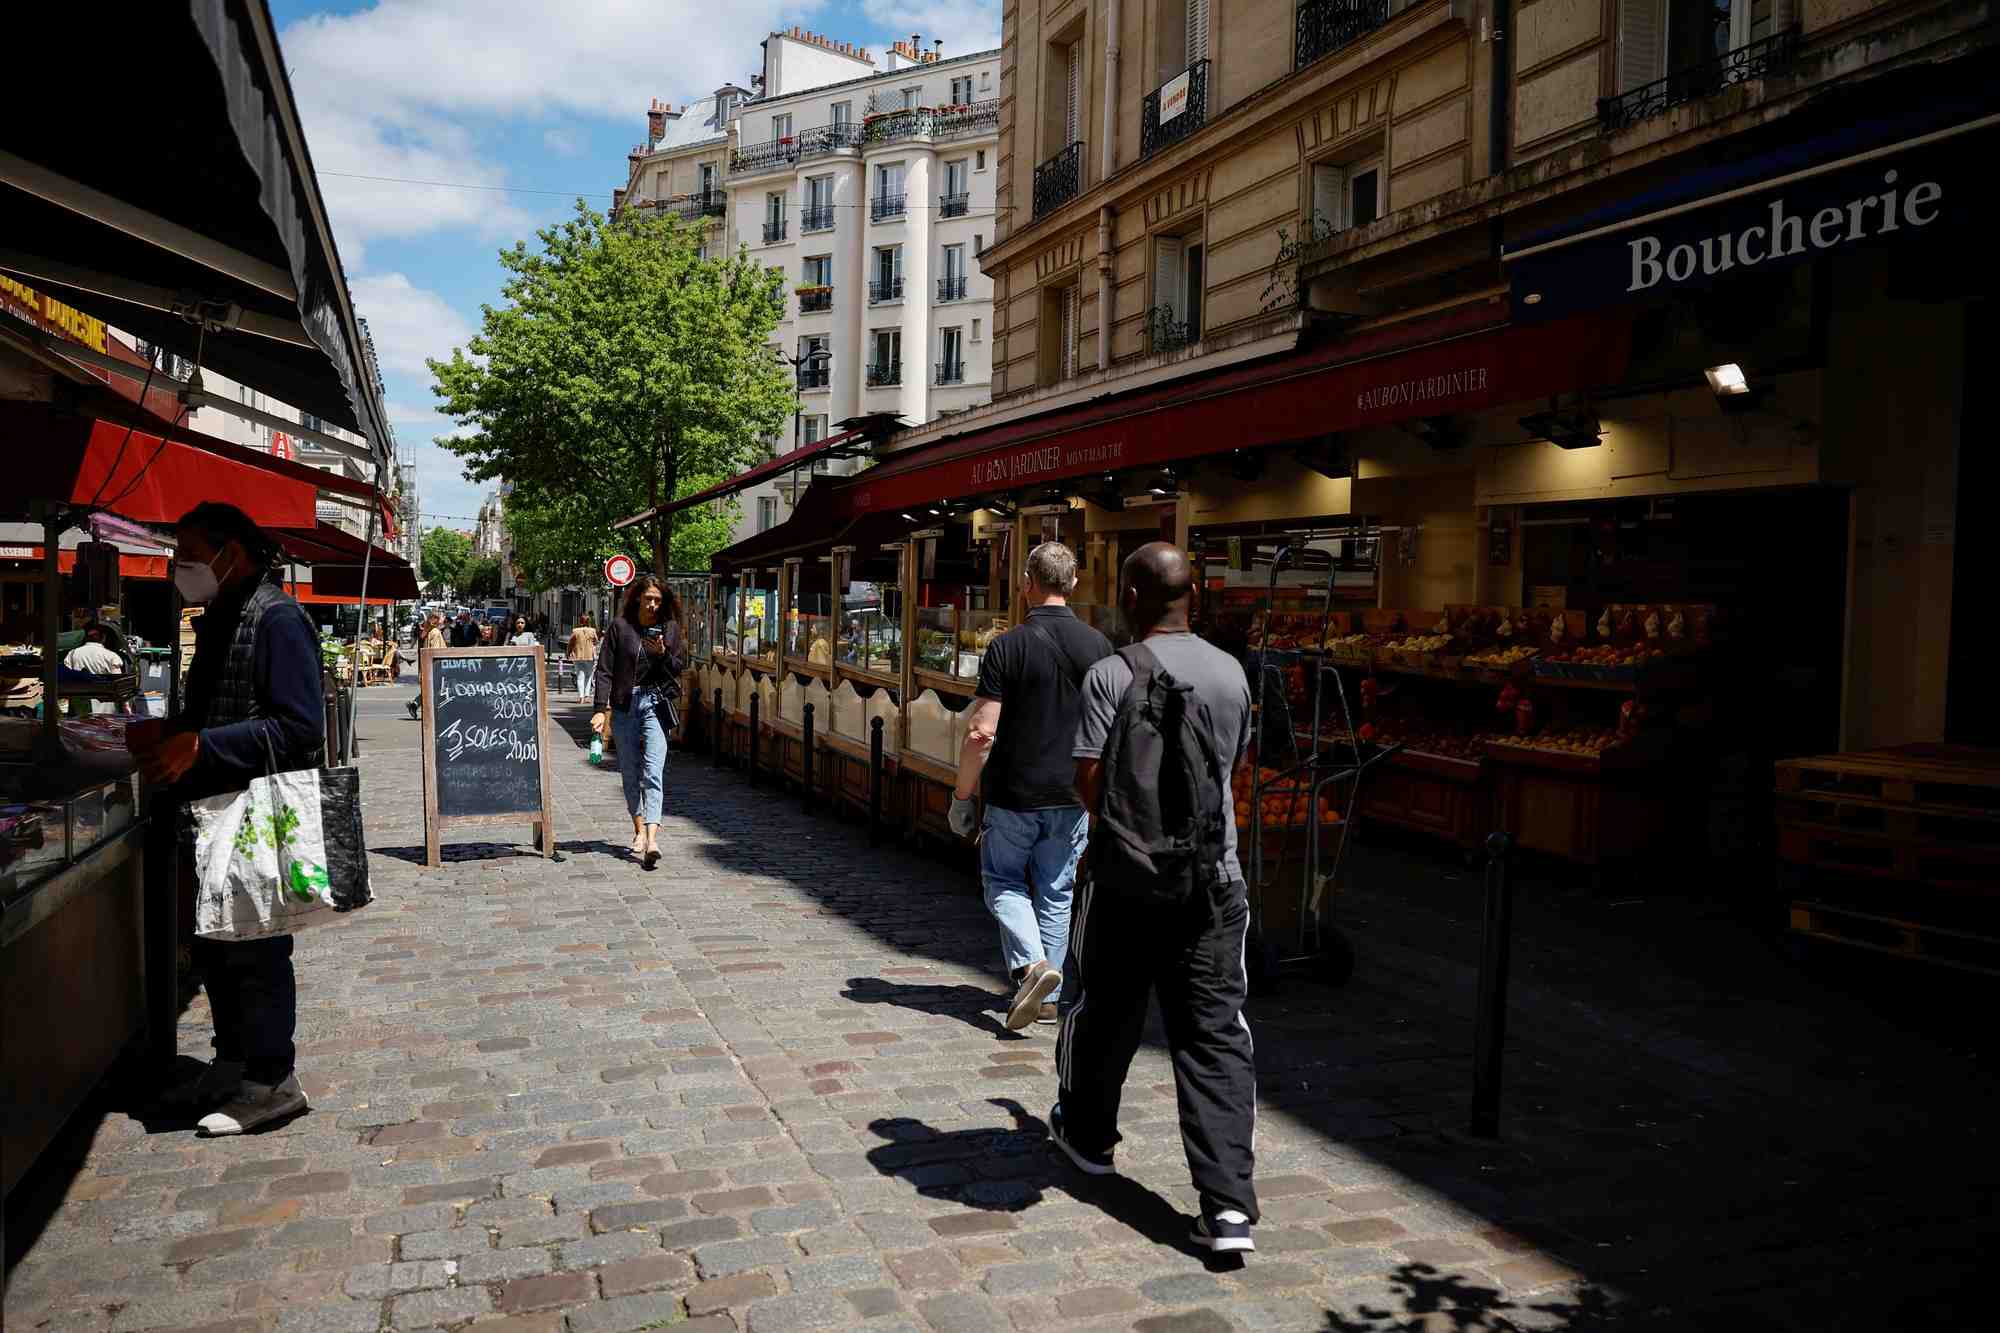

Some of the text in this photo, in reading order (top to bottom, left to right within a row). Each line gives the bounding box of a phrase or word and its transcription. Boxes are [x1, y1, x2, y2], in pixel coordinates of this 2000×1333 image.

[1626, 169, 1942, 292] Boucherie
[970, 463, 985, 486] AU
[986, 457, 1008, 482] BON
[1010, 445, 1060, 481] JARDINIER
[441, 657, 528, 673] OUVERT 7/7
[465, 725, 508, 749] SOLES
